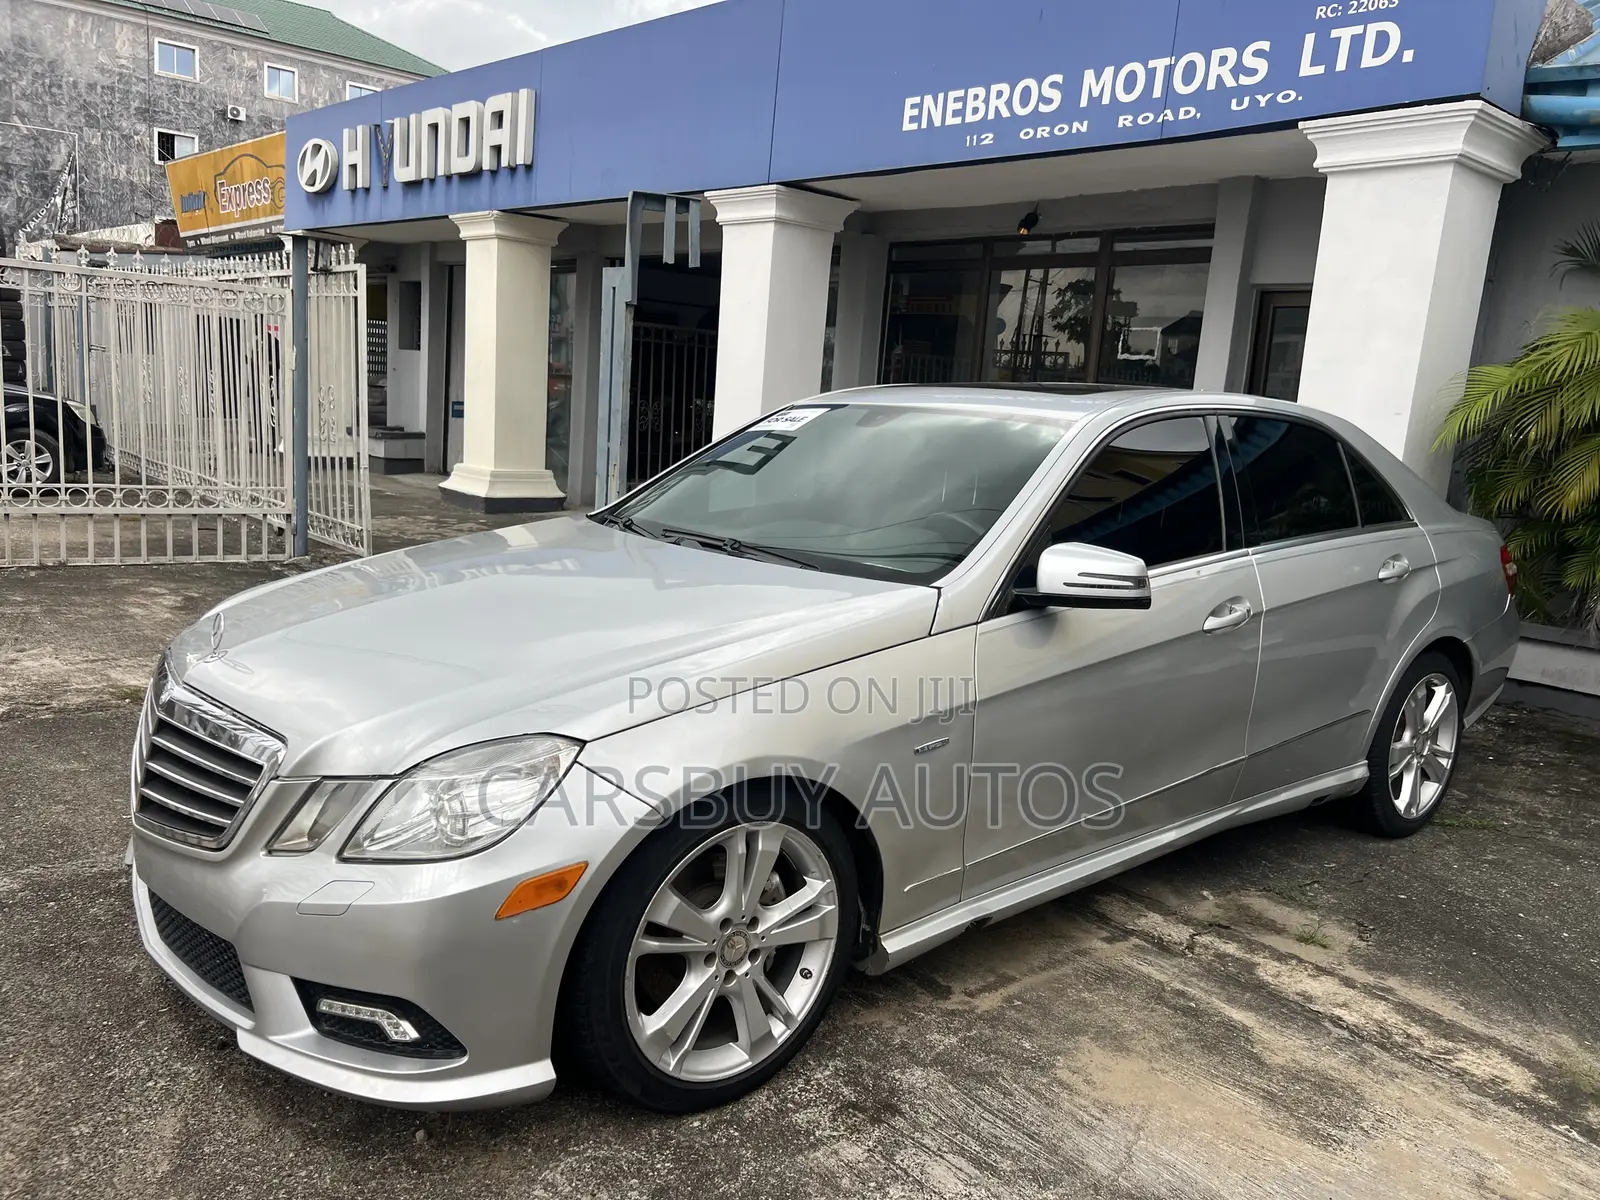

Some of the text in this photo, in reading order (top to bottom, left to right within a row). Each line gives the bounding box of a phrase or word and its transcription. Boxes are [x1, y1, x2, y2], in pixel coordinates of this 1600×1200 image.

[1315, 3, 1343, 20] RC:
[902, 21, 1415, 132] ENEBROS MOTORS LTD.
[342, 87, 536, 191] HYUNDAI
[965, 89, 1303, 147] 112 ORON ROAD, UYO.
[217, 177, 272, 218] Express
